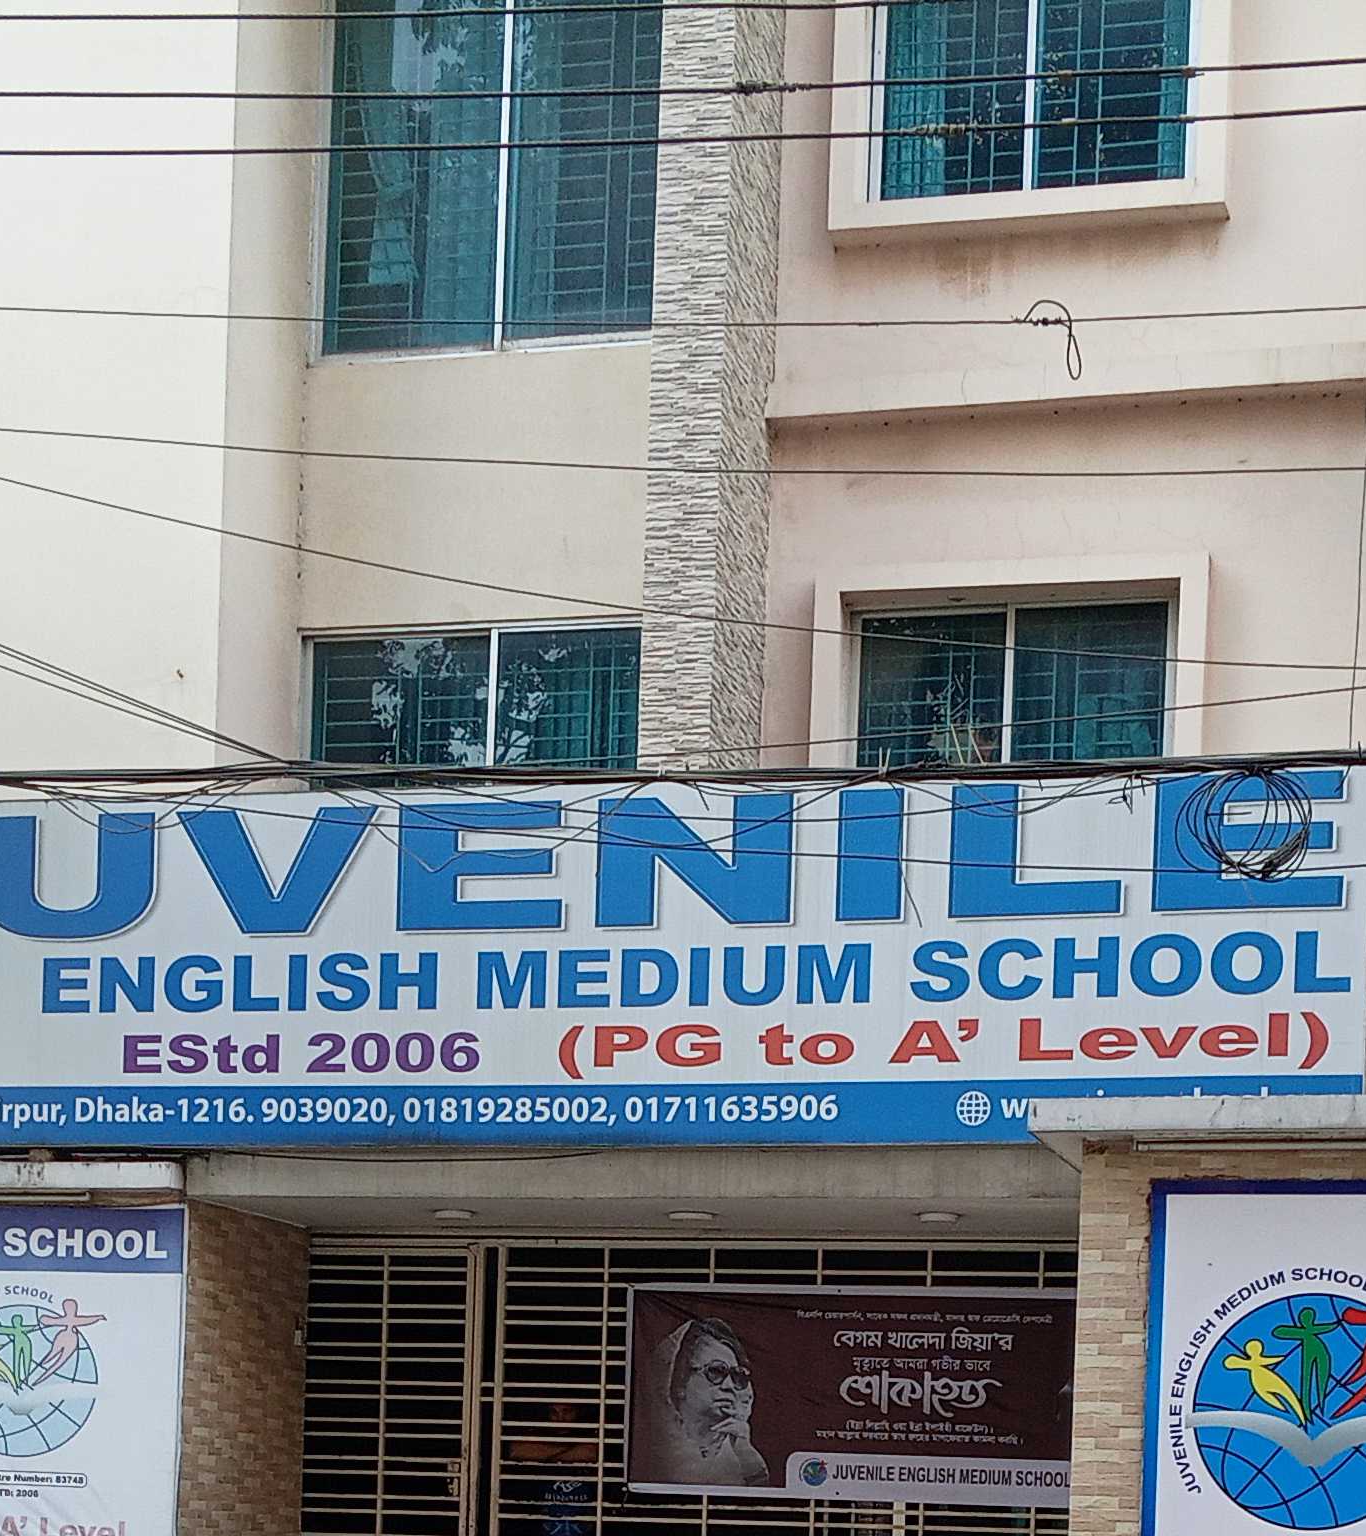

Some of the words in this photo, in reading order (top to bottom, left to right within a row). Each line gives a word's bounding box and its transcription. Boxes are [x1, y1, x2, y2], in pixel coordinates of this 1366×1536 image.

[41, 951, 438, 1014] ENGLISH
[477, 942, 872, 1010] MEDIUM
[909, 930, 1351, 1003] SCHOOL
[121, 1033, 281, 1075] EStd
[306, 1032, 481, 1075] 2006
[557, 1024, 722, 1079] (PG
[758, 1023, 855, 1067] to
[1018, 1011, 1330, 1070] Level)
[74, 1096, 256, 1126] Dhaka-1216.
[262, 1096, 396, 1127] 9039020,
[403, 1095, 614, 1126] 01819285002,
[624, 1095, 838, 1123] 01711635906
[1, 1227, 169, 1260] SCHOOL
[4, 1285, 54, 1304] SCHOOL
[1214, 1270, 1287, 1322] MEDIUM
[833, 1330, 884, 1349] বেগম
[887, 1330, 945, 1351] খালেদা
[1170, 1317, 1216, 1403] ENGLISH
[838, 1370, 1004, 1419] শোকাহত
[1168, 1404, 1202, 1495] JUVENILE
[832, 1464, 896, 1482] JUVENILE
[898, 1466, 957, 1485] ENGLISH
[959, 1468, 1012, 1486] MEDIUM
[1015, 1469, 1071, 1489] SCHOOL
